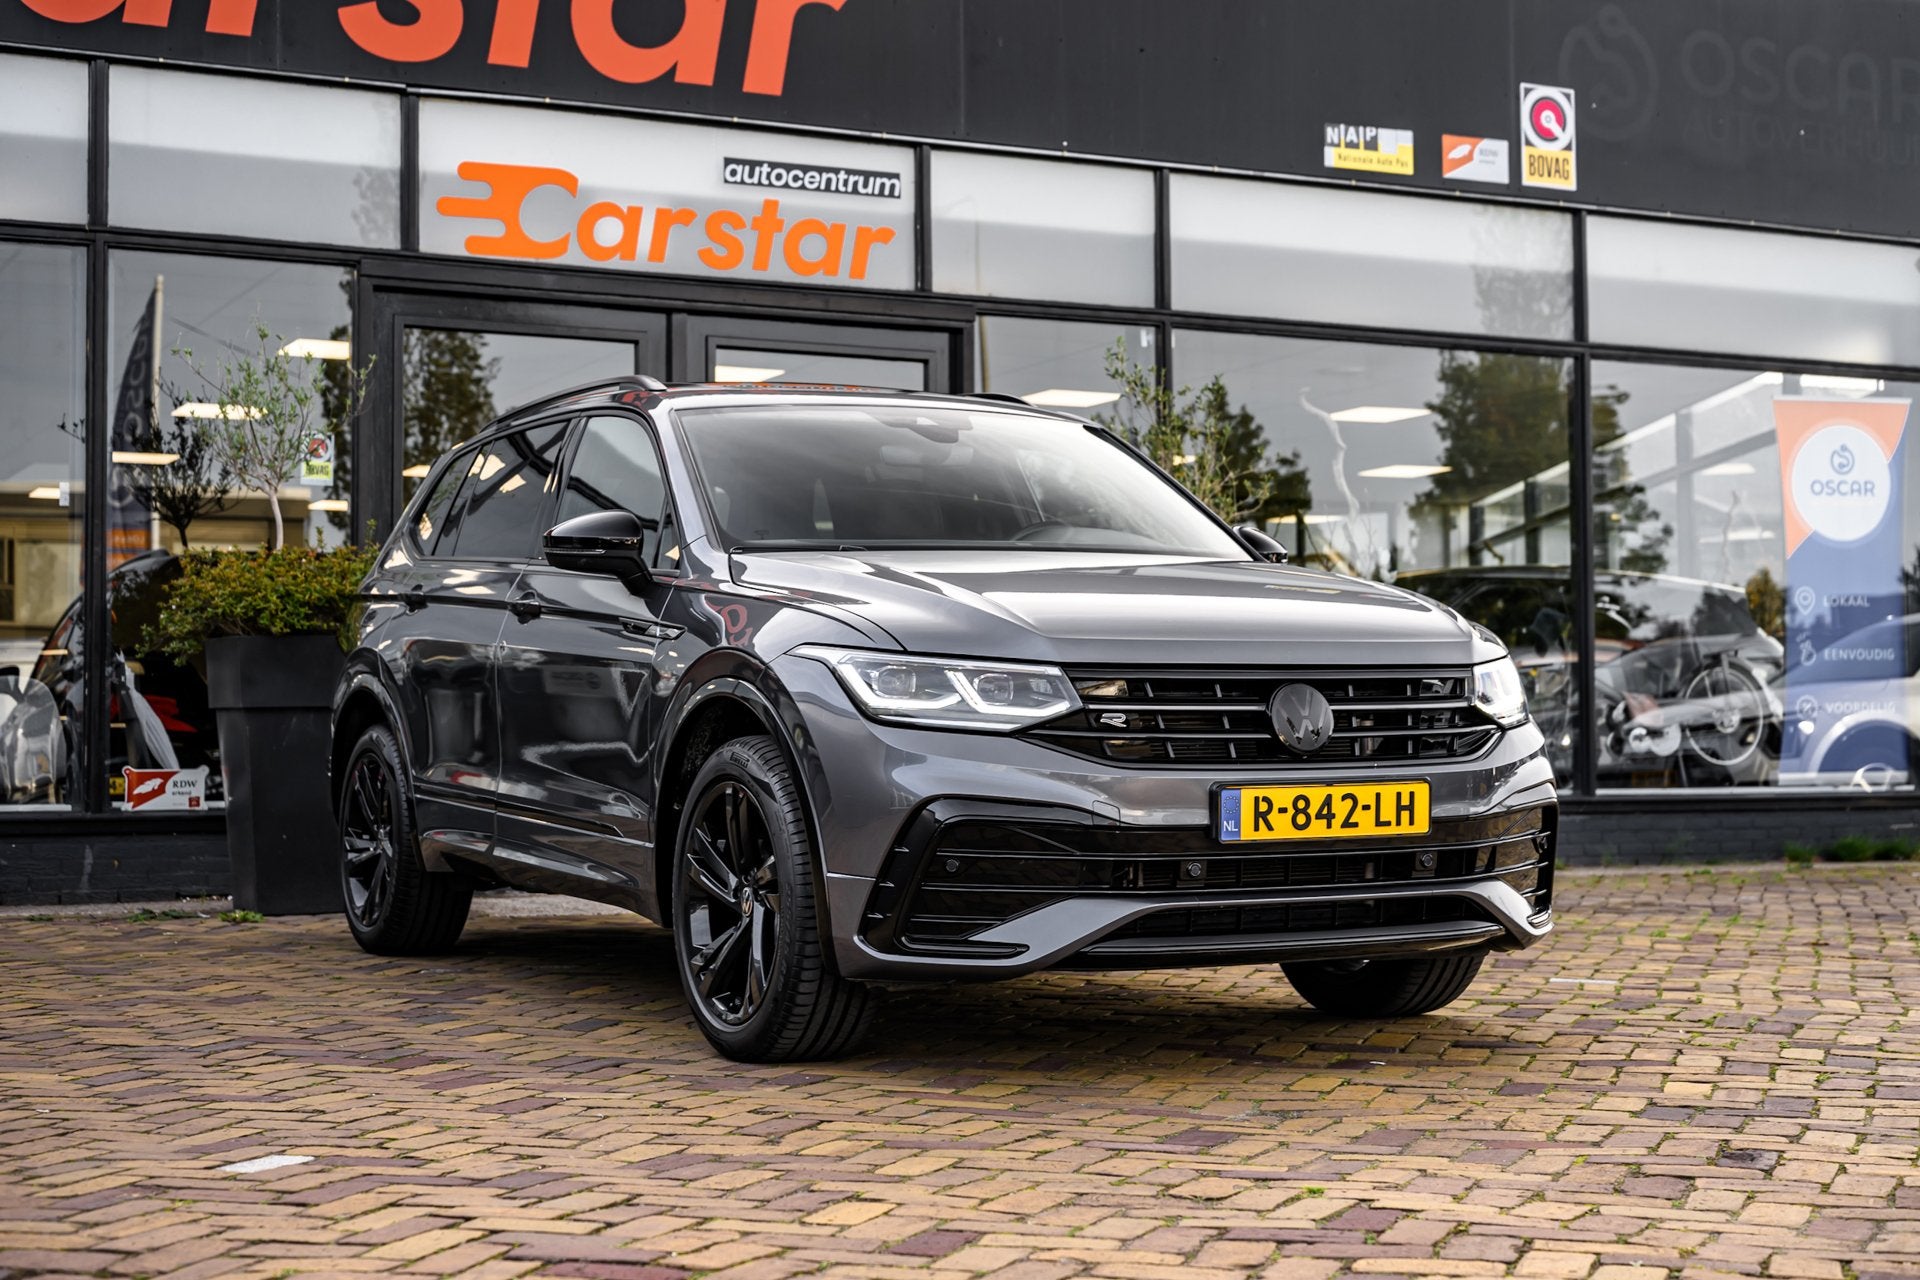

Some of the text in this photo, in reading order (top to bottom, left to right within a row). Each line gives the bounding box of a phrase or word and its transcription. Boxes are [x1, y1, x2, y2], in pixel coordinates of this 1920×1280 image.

[1528, 154, 1570, 180] BOVAG
[724, 161, 900, 197] autocentrum
[436, 161, 897, 280] Carstar
[1810, 479, 1875, 496] OSCAR
[1823, 595, 1870, 608] LOKAAL
[1824, 648, 1895, 660] EENVOUDIG
[172, 780, 198, 789] RDW
[1223, 791, 1415, 832] NL R-842-LH
